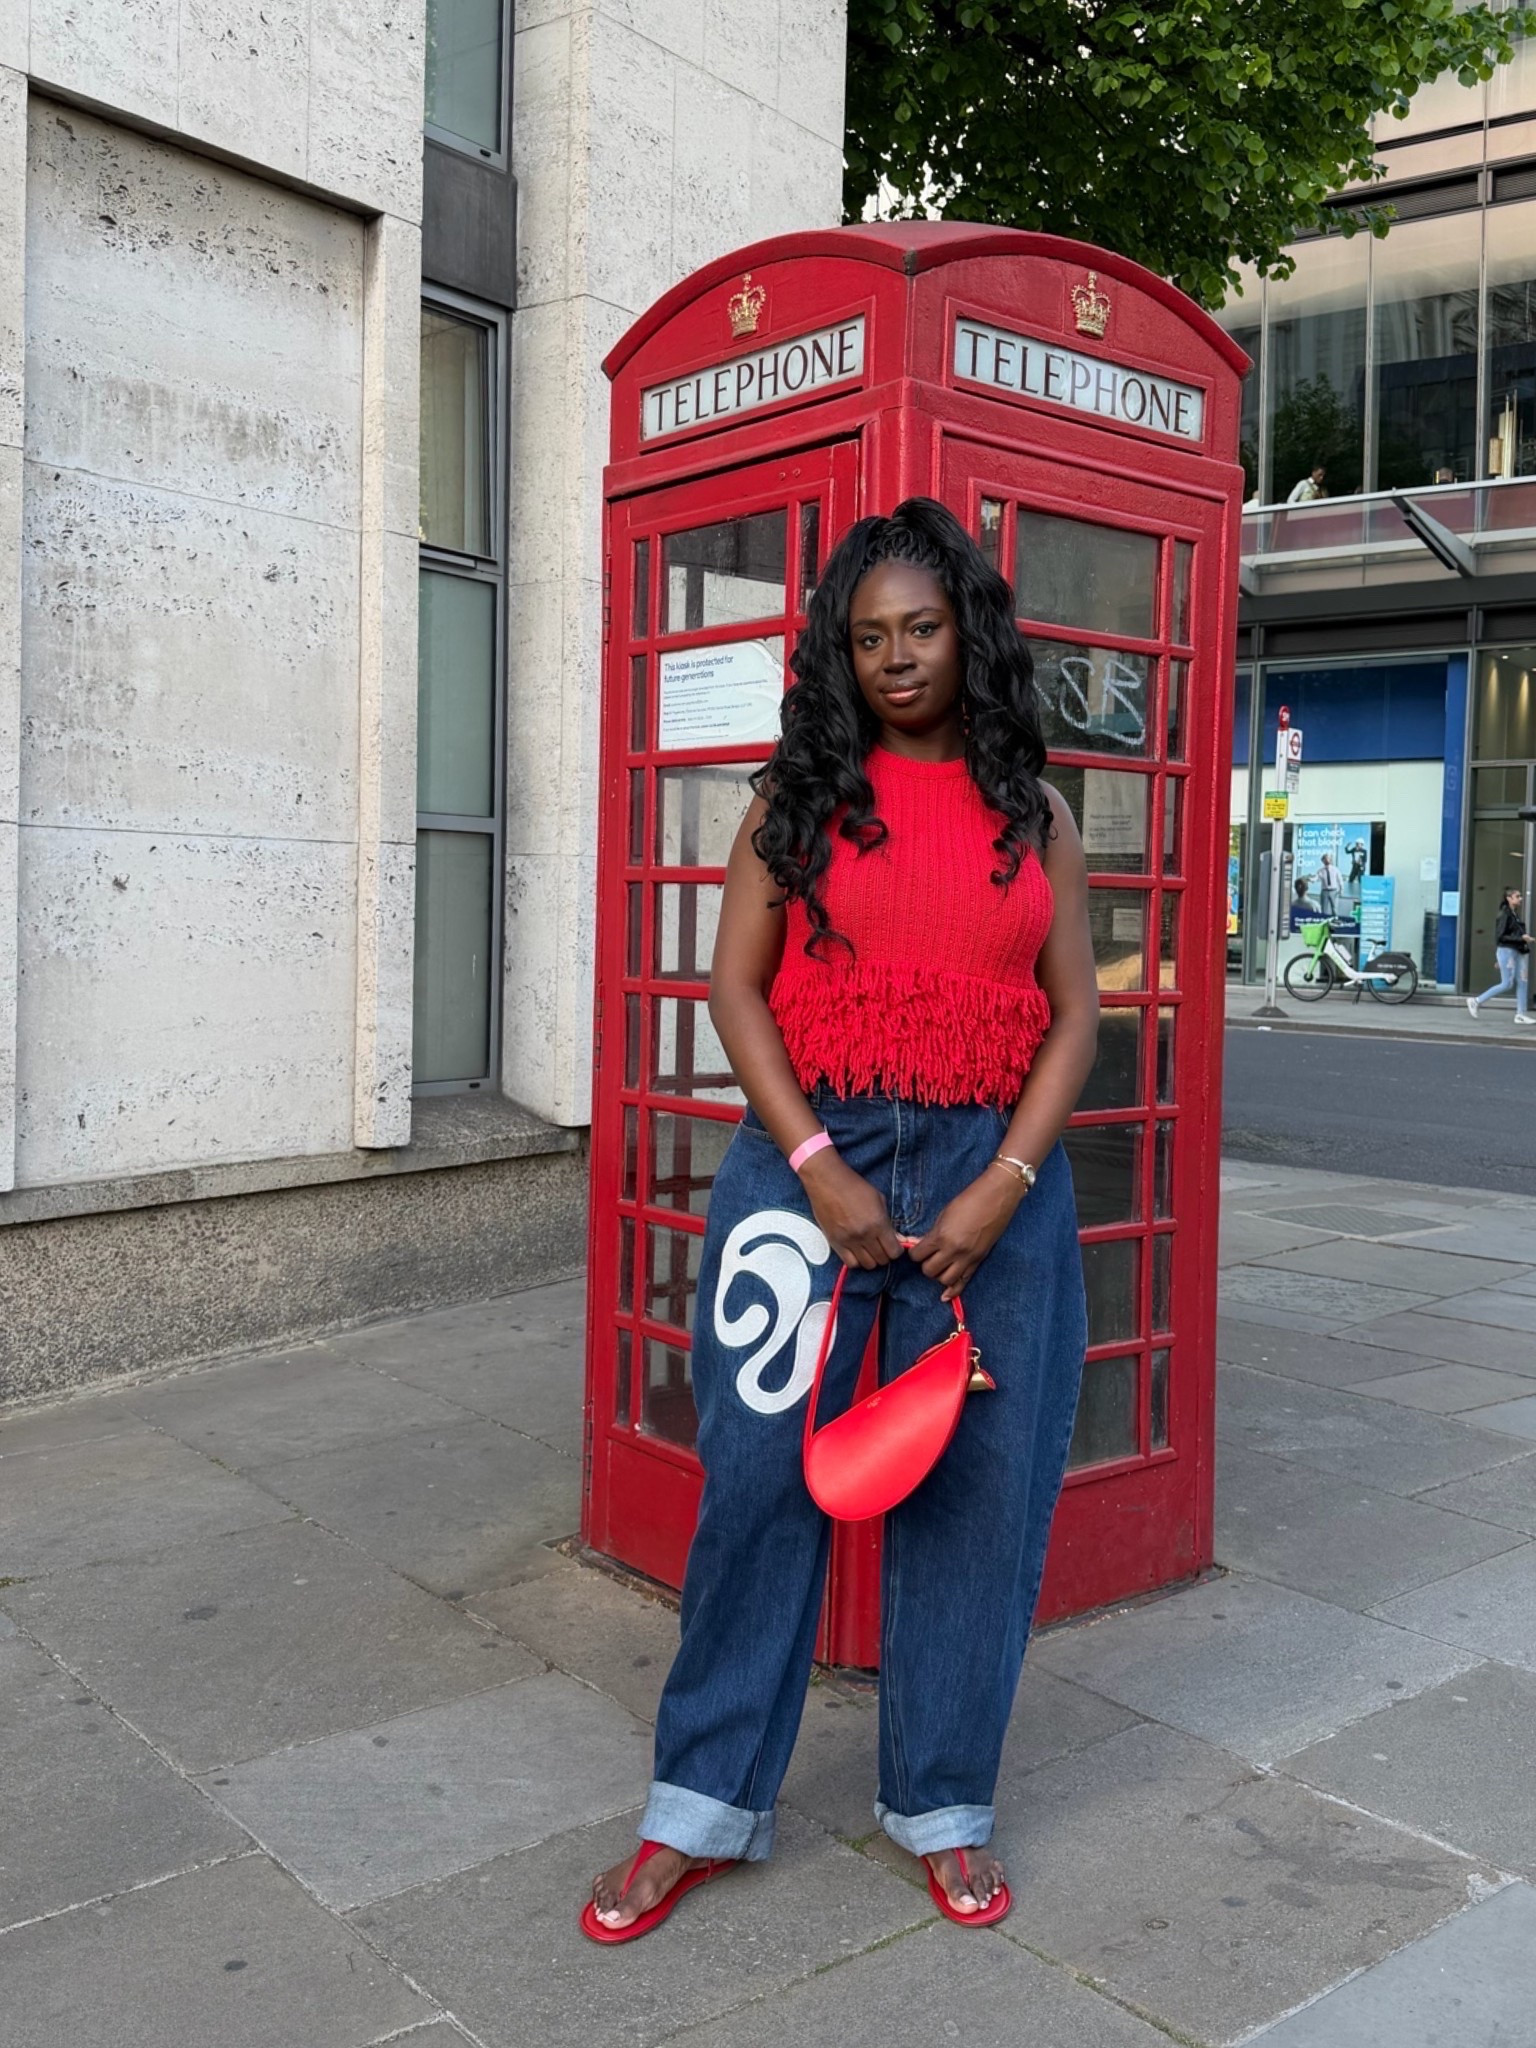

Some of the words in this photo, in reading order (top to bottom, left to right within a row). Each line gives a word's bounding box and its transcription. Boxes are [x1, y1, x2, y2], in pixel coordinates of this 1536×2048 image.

[651, 325, 858, 431] TELEPHONE
[960, 328, 1192, 435] TELEPHONE
[664, 662, 675, 671] This
[676, 660, 690, 670] kiosk
[696, 656, 724, 669] protected
[725, 655, 734, 664] for
[664, 674, 681, 683] future
[681, 670, 714, 683] generations
[1320, 827, 1345, 837] check
[1298, 837, 1317, 846] that
[1318, 837, 1343, 846] blood
